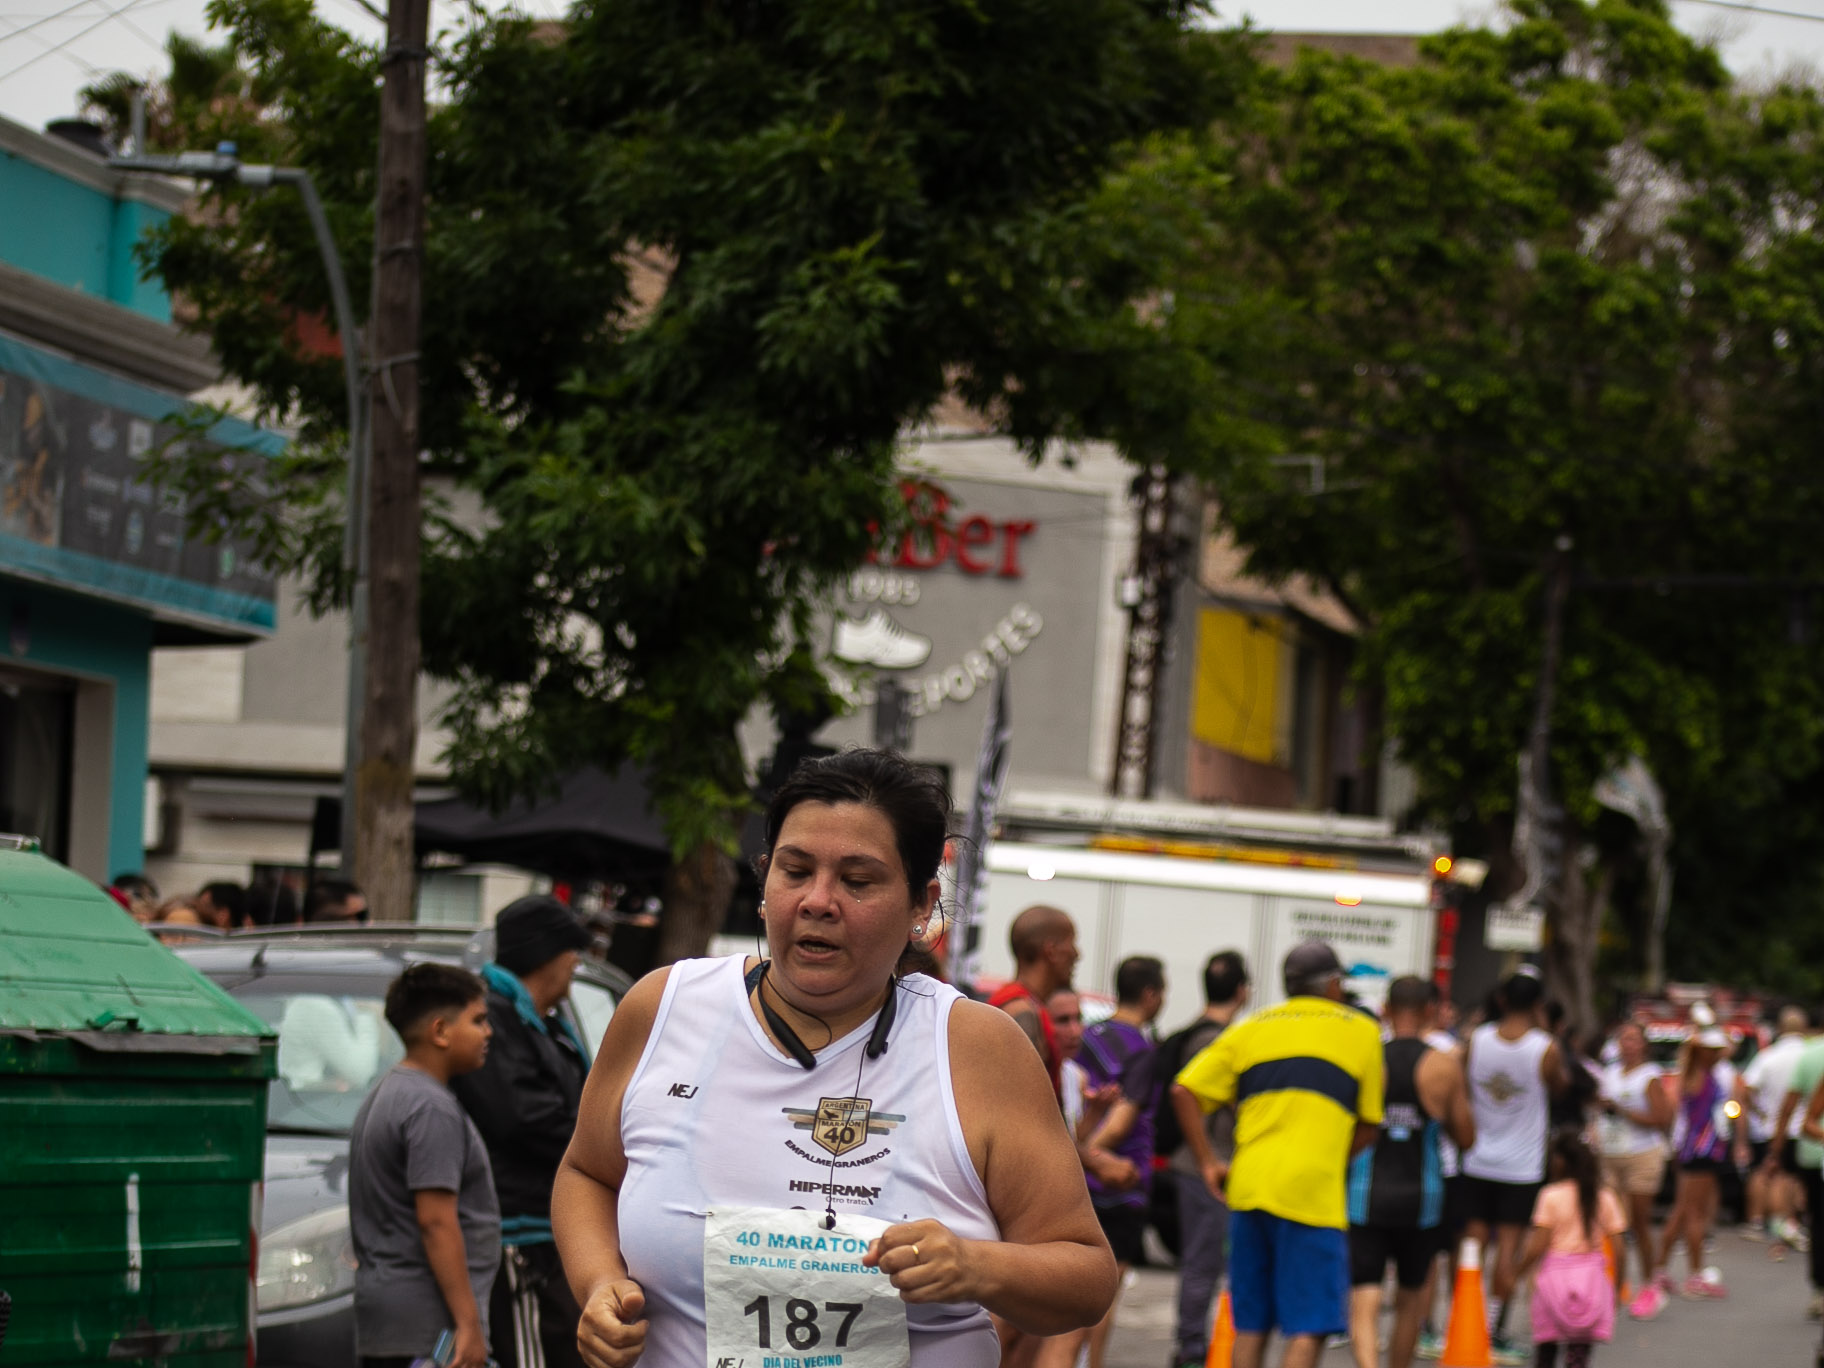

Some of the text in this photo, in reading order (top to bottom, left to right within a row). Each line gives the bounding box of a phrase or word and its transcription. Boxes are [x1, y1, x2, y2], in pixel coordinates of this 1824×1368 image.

[667, 1083, 699, 1099] NEJ
[824, 1102, 865, 1110] ARGENTNA
[823, 1127, 855, 1144] 40
[784, 1139, 891, 1168] EMPALME GRANEROS
[736, 1231, 869, 1254] 40 MARATON
[729, 1255, 879, 1275] EMPALME GRANEROS
[744, 1296, 864, 1351] 187
[763, 1355, 843, 1368] DIA DEL VECINO
